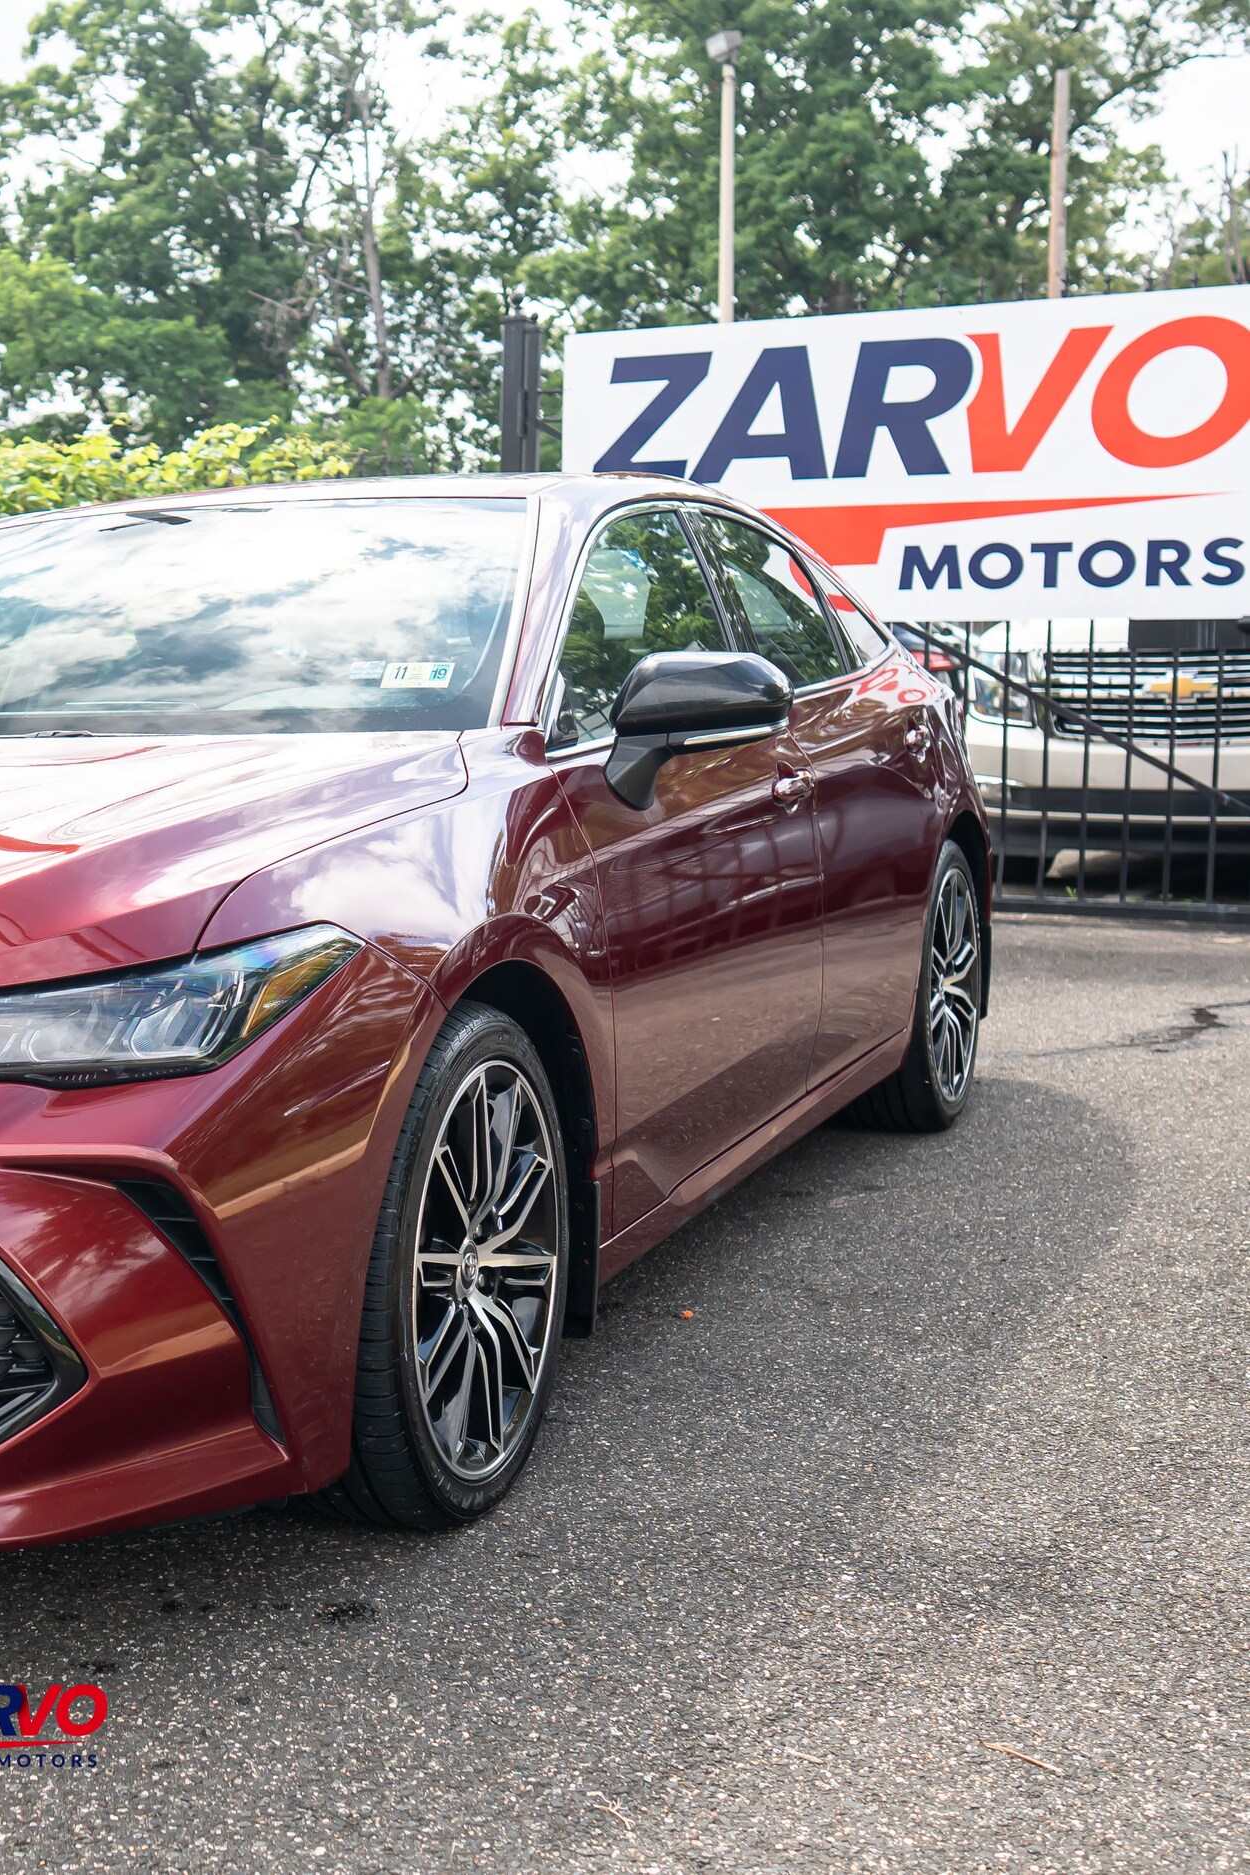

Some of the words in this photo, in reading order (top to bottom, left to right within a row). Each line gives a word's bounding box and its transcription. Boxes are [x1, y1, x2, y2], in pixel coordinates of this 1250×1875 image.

[593, 315, 1250, 483] ZARVO
[898, 537, 1246, 591] MOTORS
[394, 666, 409, 680] 11
